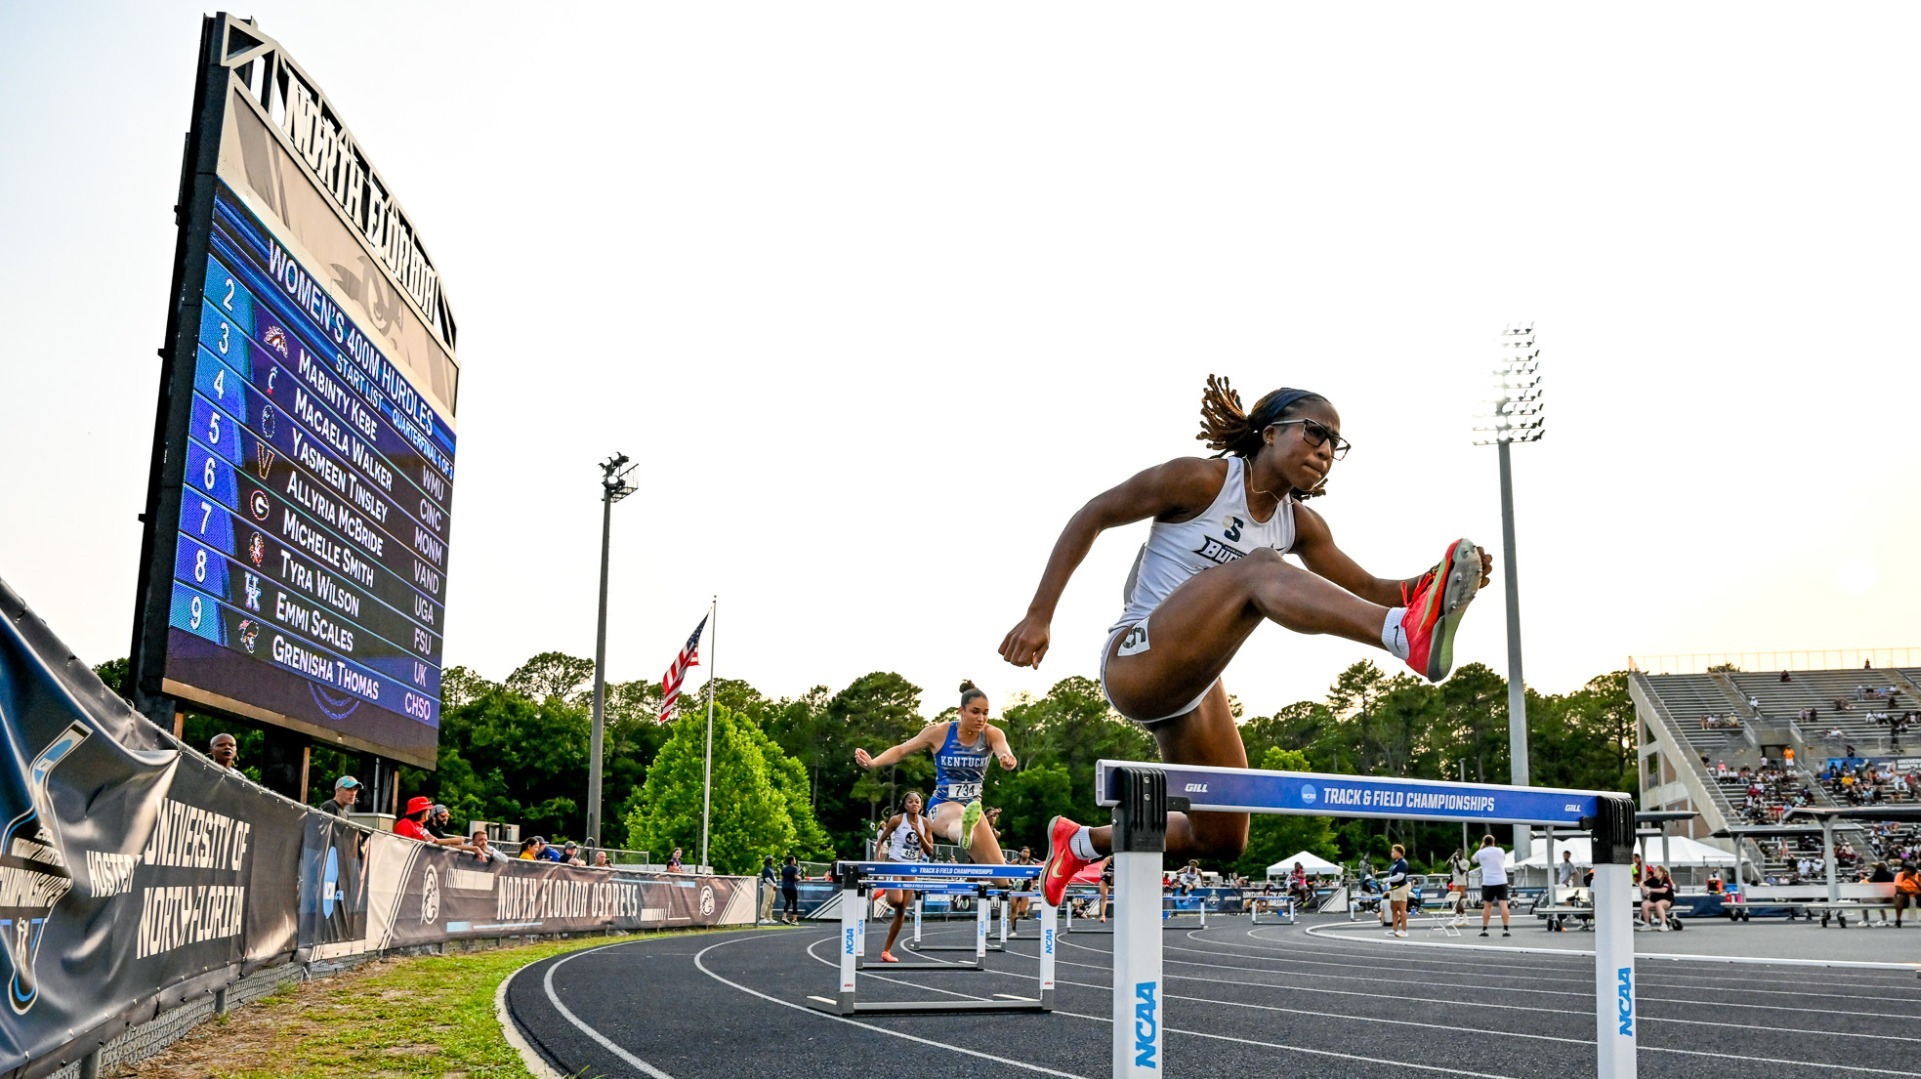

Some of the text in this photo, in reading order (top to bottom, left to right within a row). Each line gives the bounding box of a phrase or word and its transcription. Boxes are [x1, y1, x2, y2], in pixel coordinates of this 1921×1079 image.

[282, 66, 438, 325] NORTH FLORIDA
[268, 238, 434, 436] WOMEN'S 400M HURDLES
[222, 278, 444, 501] 2 MABINTY KEBE WMU
[336, 353, 383, 412] START LIST
[213, 369, 443, 566] 4 YASMEEN TINSLEY MONM
[218, 322, 442, 532] 3 MACAELA WALKER CINC
[392, 409, 437, 465] QUARTERFINAL
[204, 457, 435, 626] 6 MICHELLE SMITH UGA
[208, 411, 221, 444] 5
[286, 470, 336, 525] ALLYRIA
[413, 559, 440, 595] VAND
[194, 549, 427, 688] 8 EMMI SCALES UK
[200, 501, 432, 656] 7 TYRA WILSON FSU
[190, 596, 431, 721] 9 GRENISHA THOMAS CHSO
[955, 784, 976, 797] 734
[1184, 782, 1208, 793] GILL
[1324, 787, 1495, 812] TRACK & FIELD CHAMPIONSHIPS
[145, 797, 250, 872] UNIVERSITY OF
[136, 886, 193, 960] NORTH
[188, 885, 244, 944] FLORIDA
[496, 875, 638, 920] NORTH FLORIDA OSPREYS
[846, 928, 854, 955] NCAA
[1045, 929, 1053, 954] NCAA
[1135, 981, 1156, 1069] NCAA
[1618, 967, 1633, 1037] NCAA
